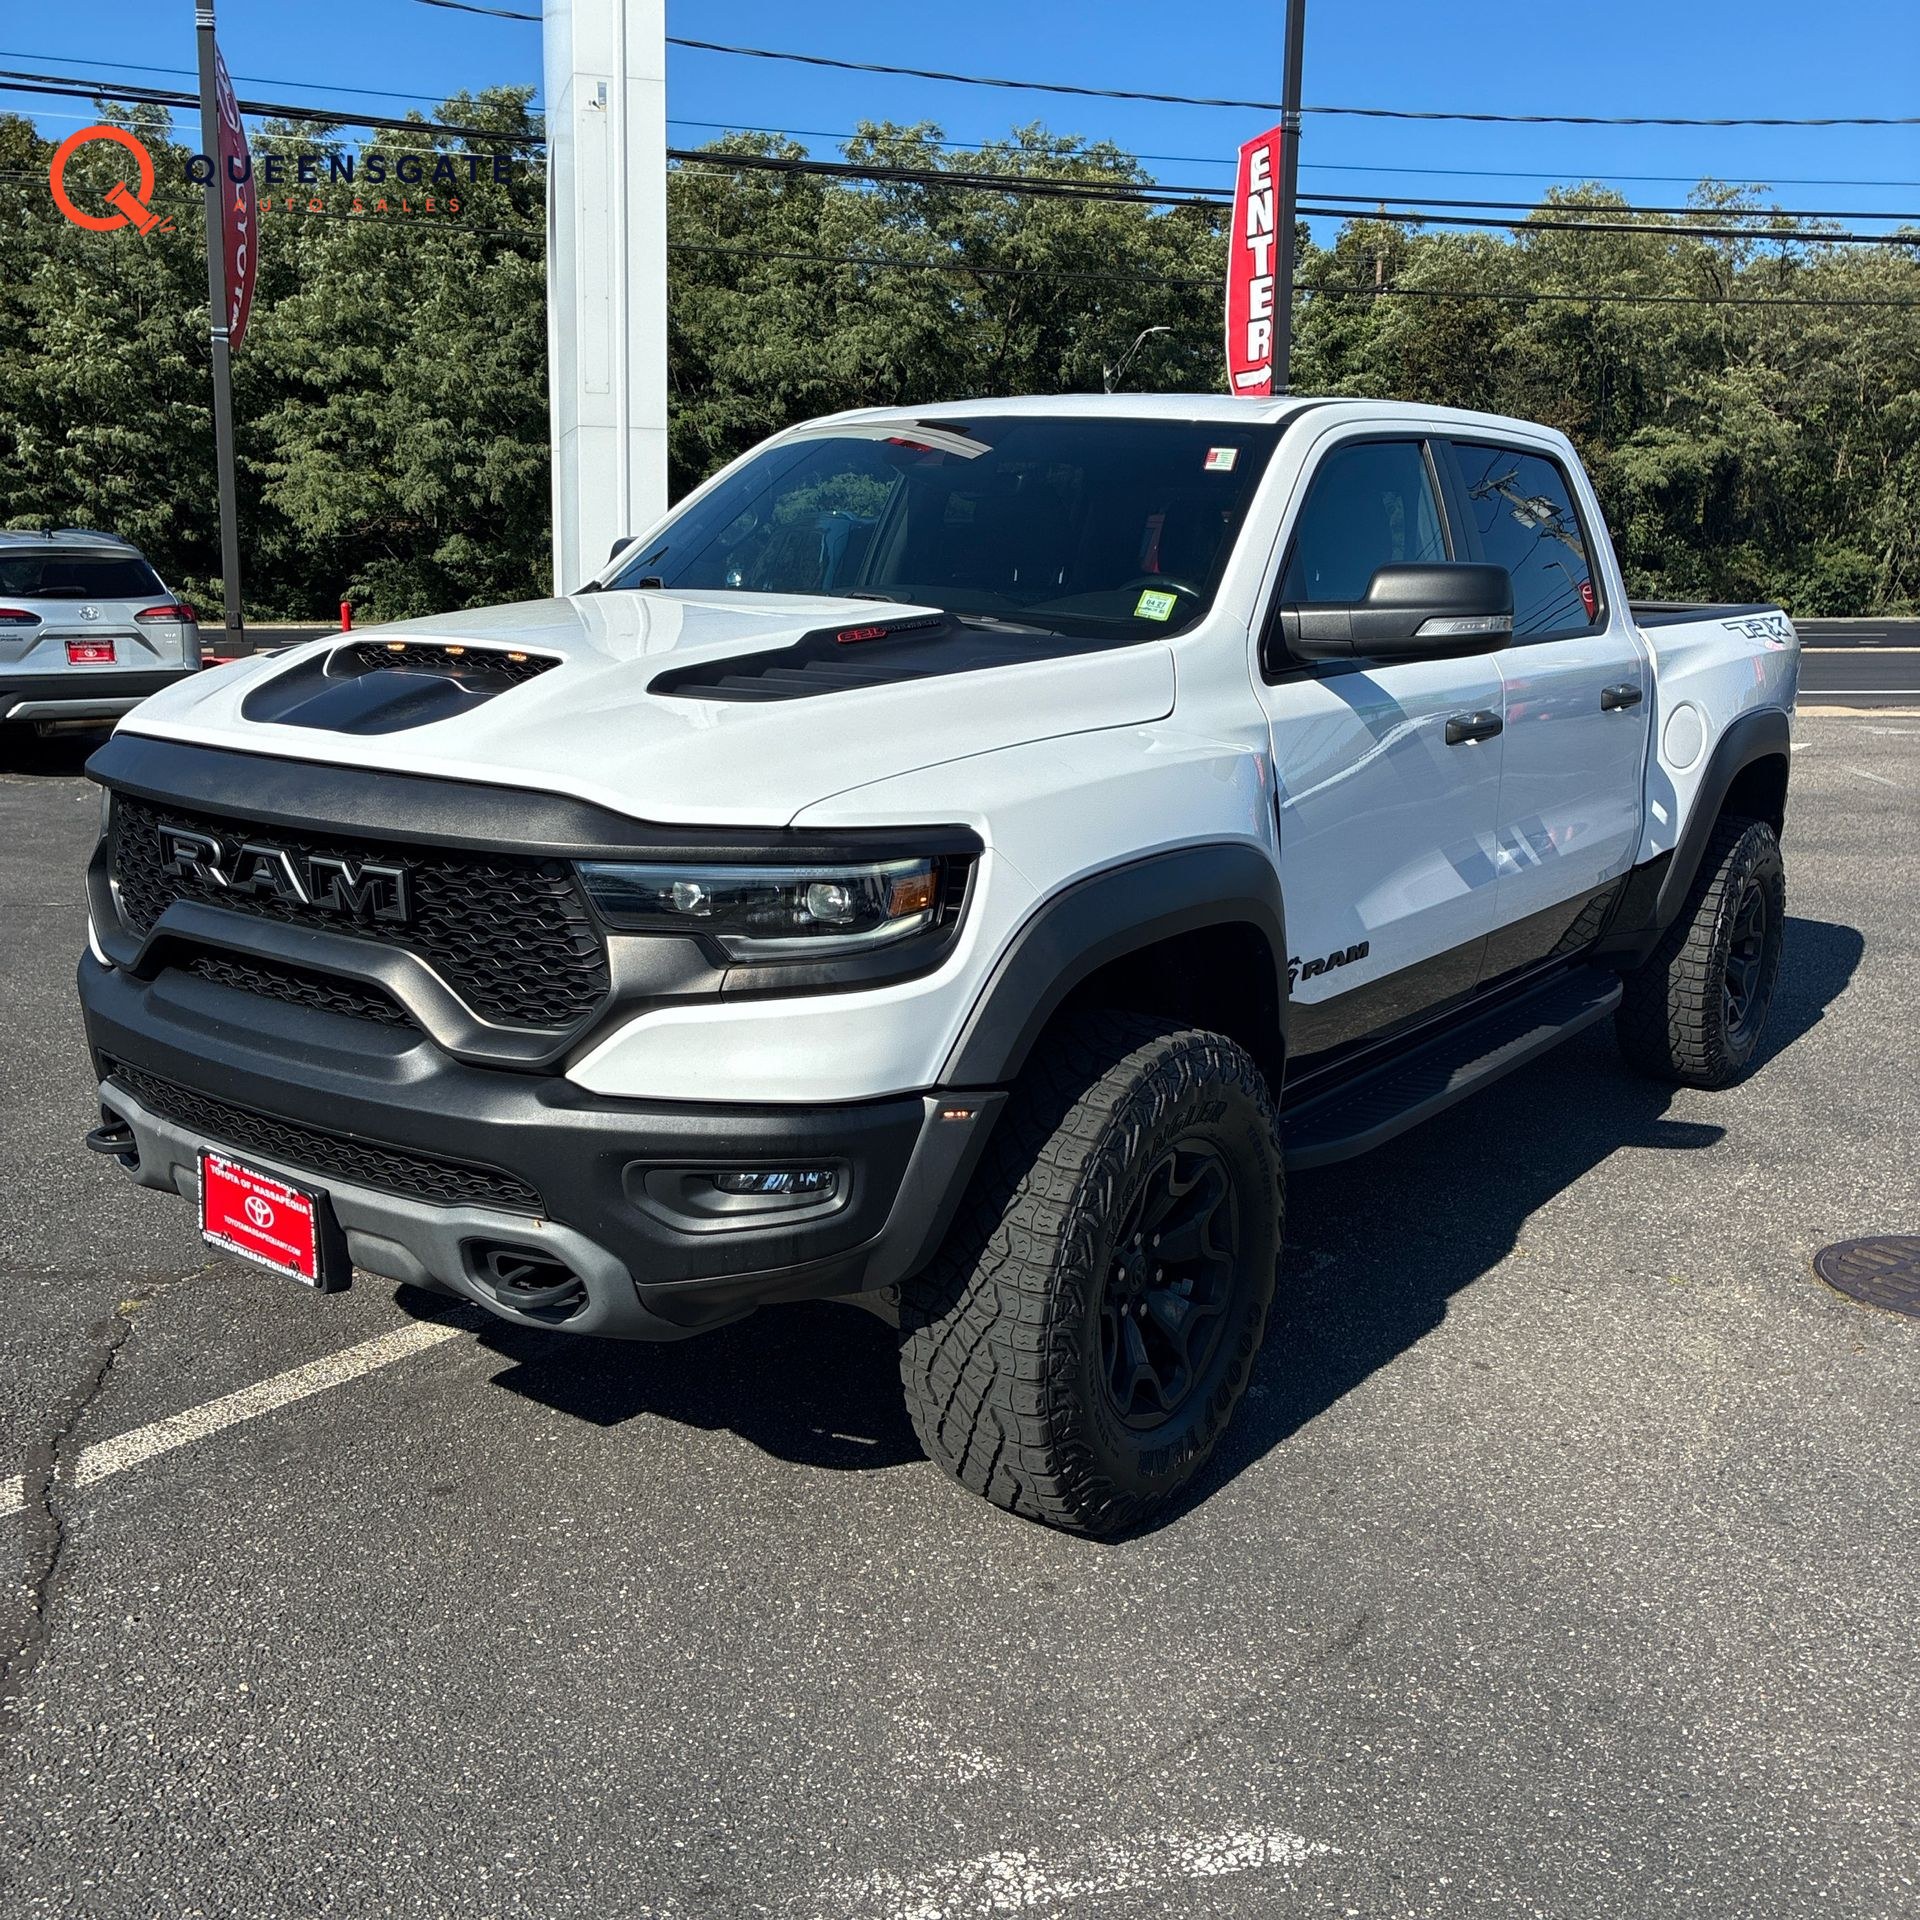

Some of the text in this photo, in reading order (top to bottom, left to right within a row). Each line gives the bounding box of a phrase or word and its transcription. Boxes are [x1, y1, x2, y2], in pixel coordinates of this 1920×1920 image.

[1246, 145, 1274, 363] ENTER
[1721, 616, 1792, 644] TRX
[158, 824, 410, 922] RAM
[1301, 940, 1370, 982] RAM
[210, 1164, 240, 1186] TOYOTA
[240, 1178, 252, 1190] OF
